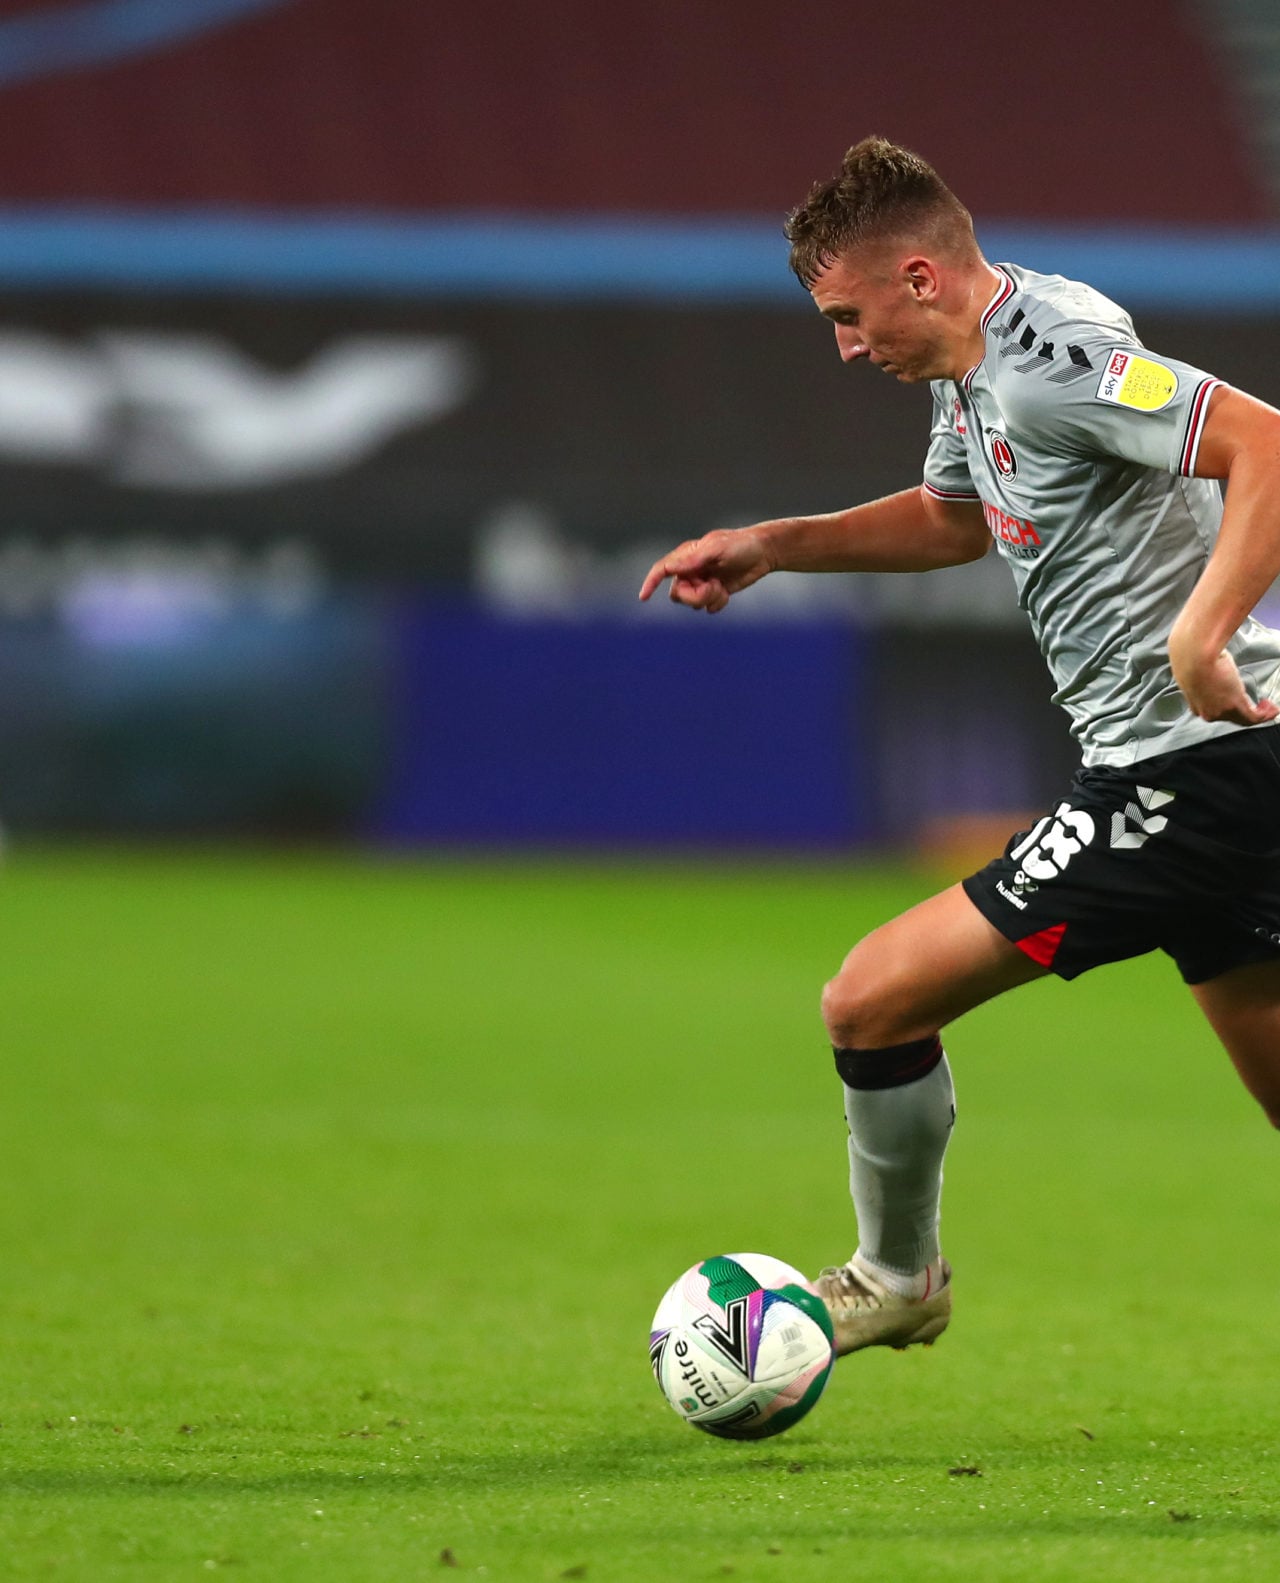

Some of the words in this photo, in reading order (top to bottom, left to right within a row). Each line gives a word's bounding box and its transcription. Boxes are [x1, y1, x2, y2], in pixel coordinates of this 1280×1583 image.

[1110, 355, 1127, 375] bet
[1104, 375, 1119, 397] sky
[995, 879, 1028, 911] hummel
[674, 1340, 719, 1407] mitre
